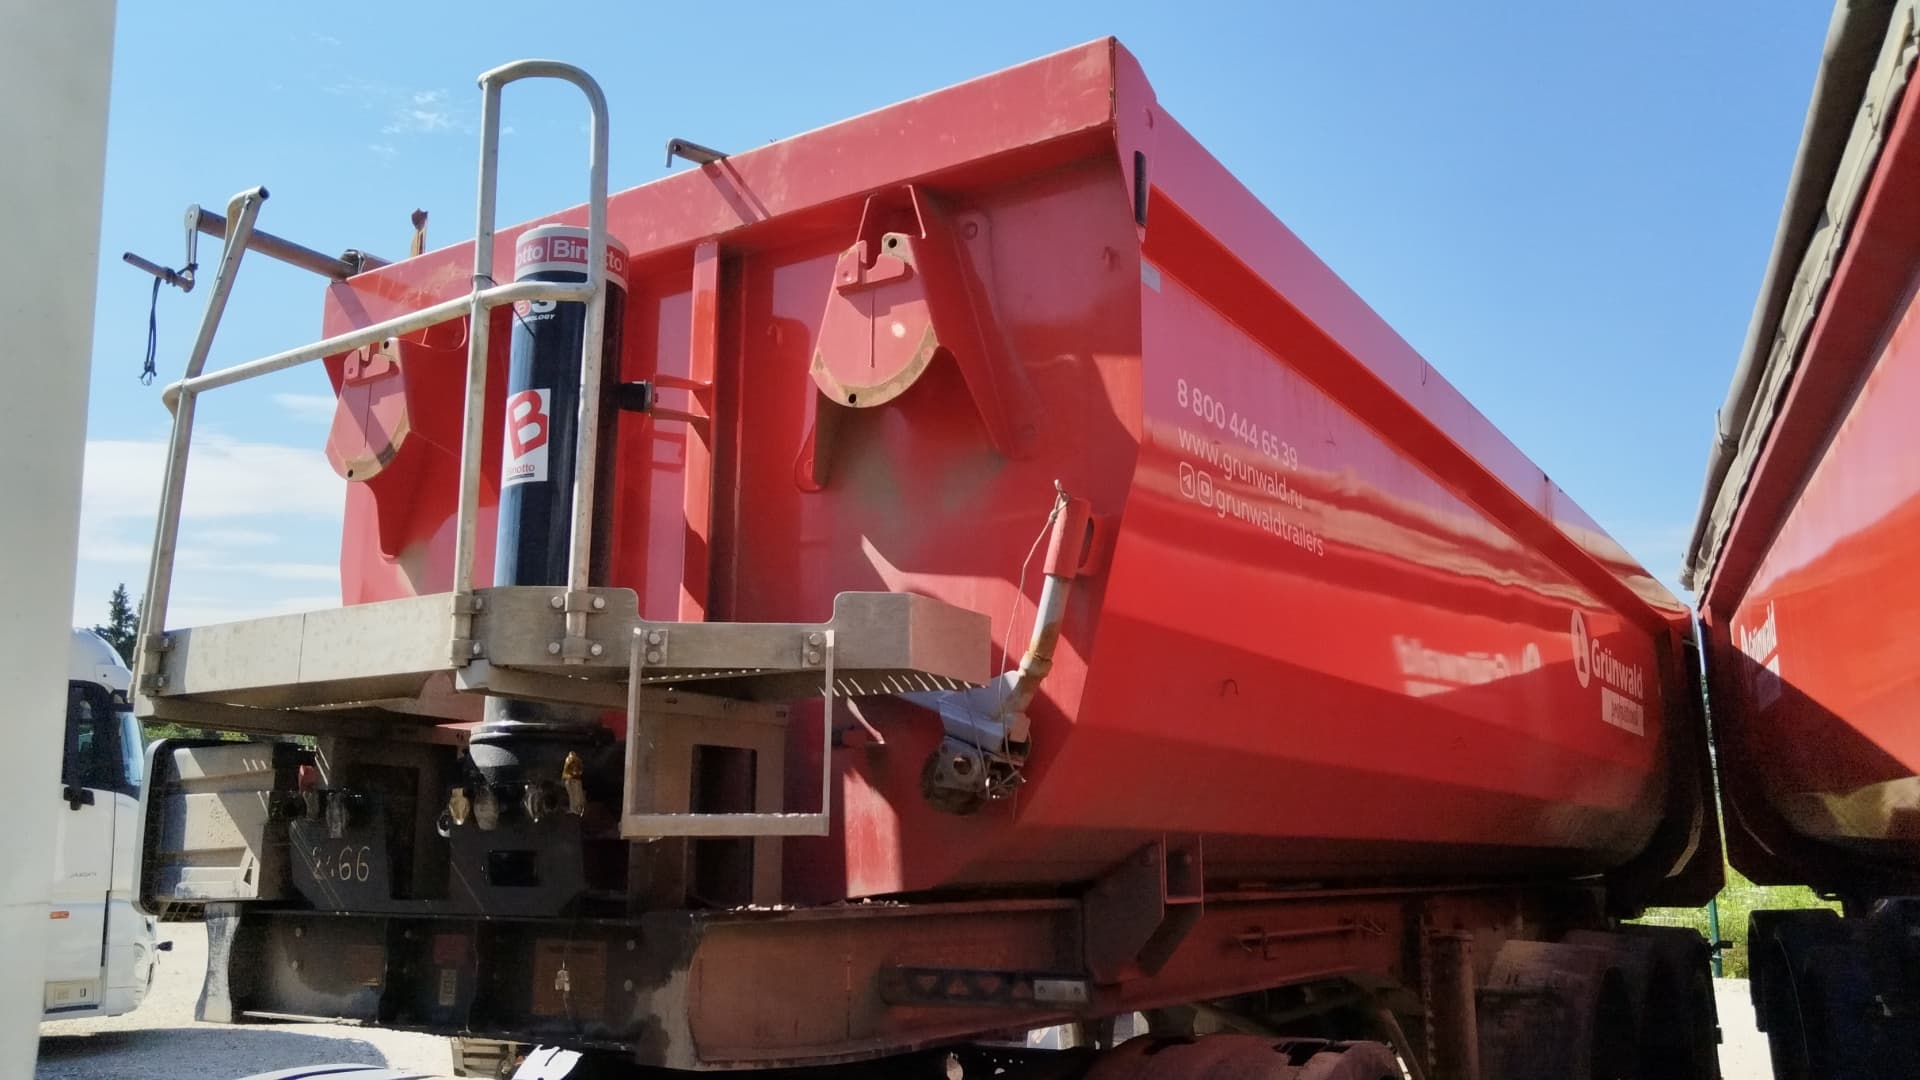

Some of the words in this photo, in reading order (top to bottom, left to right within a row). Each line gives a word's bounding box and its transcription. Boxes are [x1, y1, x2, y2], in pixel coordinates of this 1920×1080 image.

[553, 239, 622, 271] Binto
[1177, 378, 1188, 409] 8
[1192, 387, 1226, 430] 800
[1229, 412, 1259, 449] 444
[1261, 429, 1280, 461] 65
[1281, 441, 1298, 472] 39
[1178, 426, 1303, 510] www.grunwald.ru
[1216, 489, 1324, 557] grunwaldtrailers
[1591, 637, 1644, 700] Grünwald
